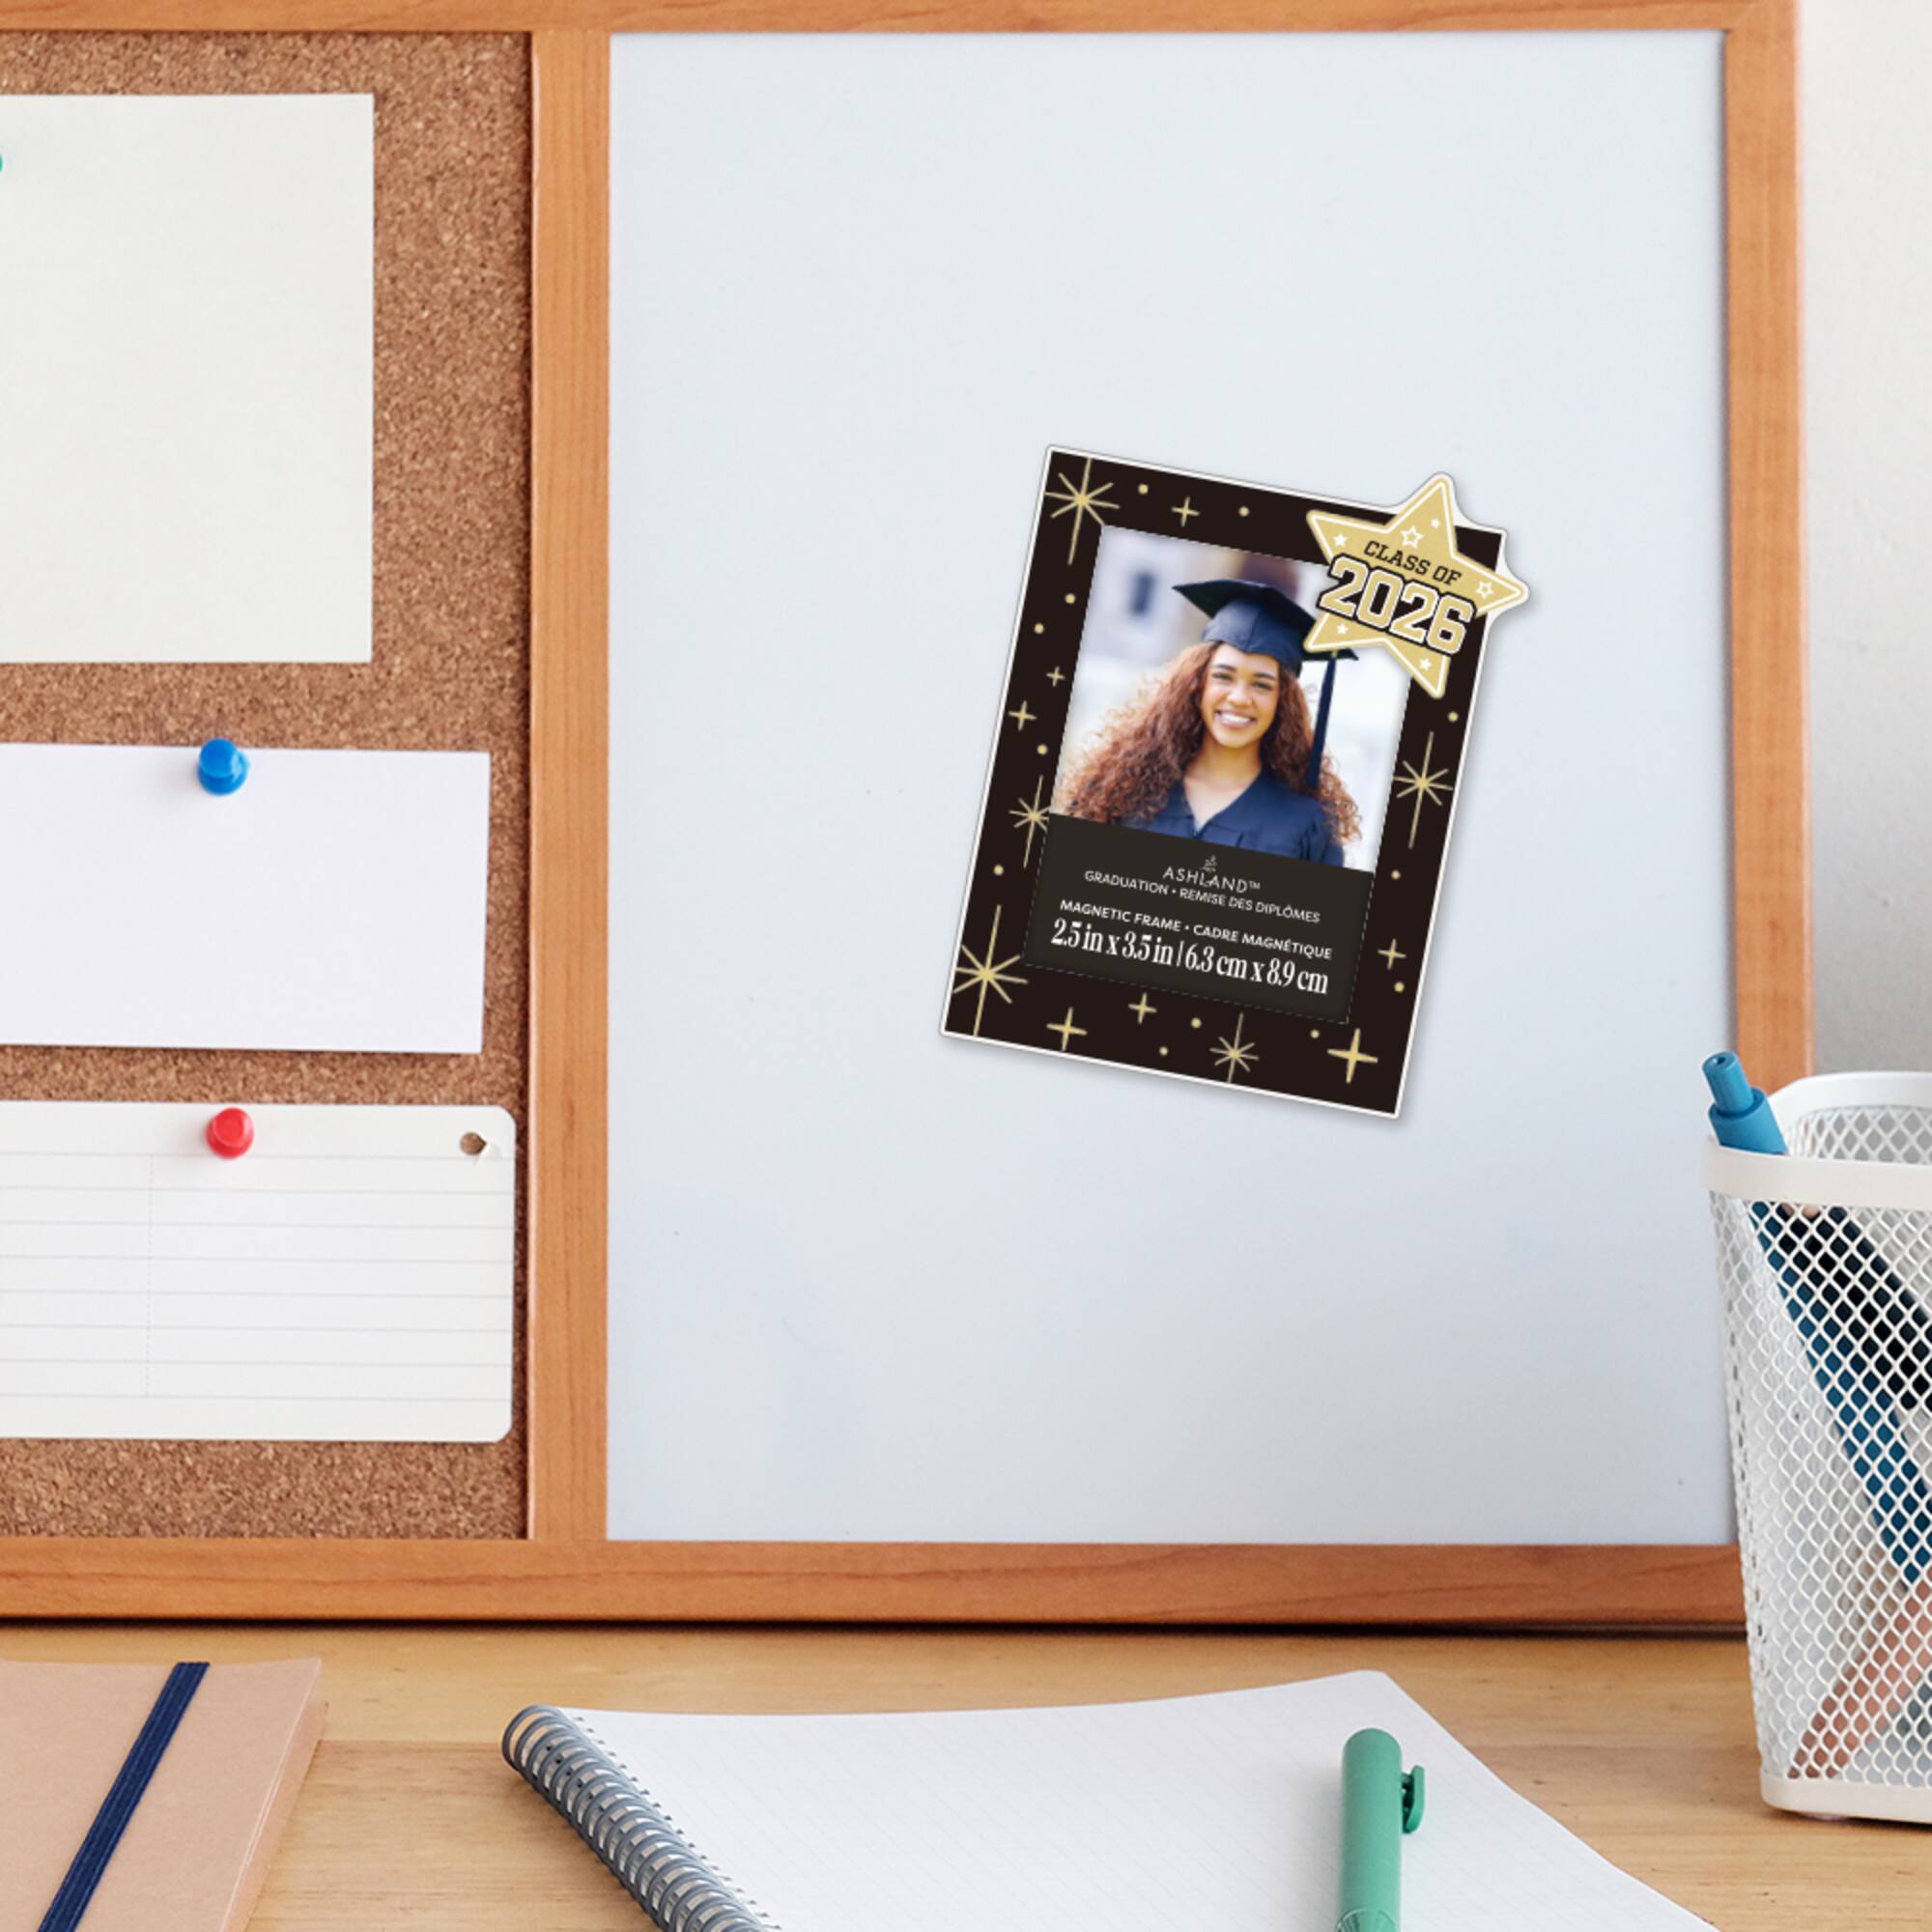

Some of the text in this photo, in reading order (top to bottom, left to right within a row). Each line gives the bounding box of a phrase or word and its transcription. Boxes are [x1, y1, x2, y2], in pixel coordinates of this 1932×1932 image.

[1363, 540, 1463, 585] CLASS OF
[1317, 553, 1477, 657] 2026
[1084, 869, 1321, 923] GRADUATION REMISE DES DIPLÔMES
[1050, 917, 1083, 948] 2.5
[1082, 923, 1104, 953] in
[1105, 933, 1121, 955] x
[1122, 930, 1152, 961] 3.5
[1151, 936, 1174, 965] in
[1184, 942, 1214, 973] 6.3
[1215, 954, 1248, 980] cm
[1249, 961, 1264, 982] x
[1266, 957, 1295, 987] 8.9
[1296, 969, 1329, 995] cm
[1060, 899, 1333, 960] MAGNETIC FRAME CADRE MAGNÉTIQUE
